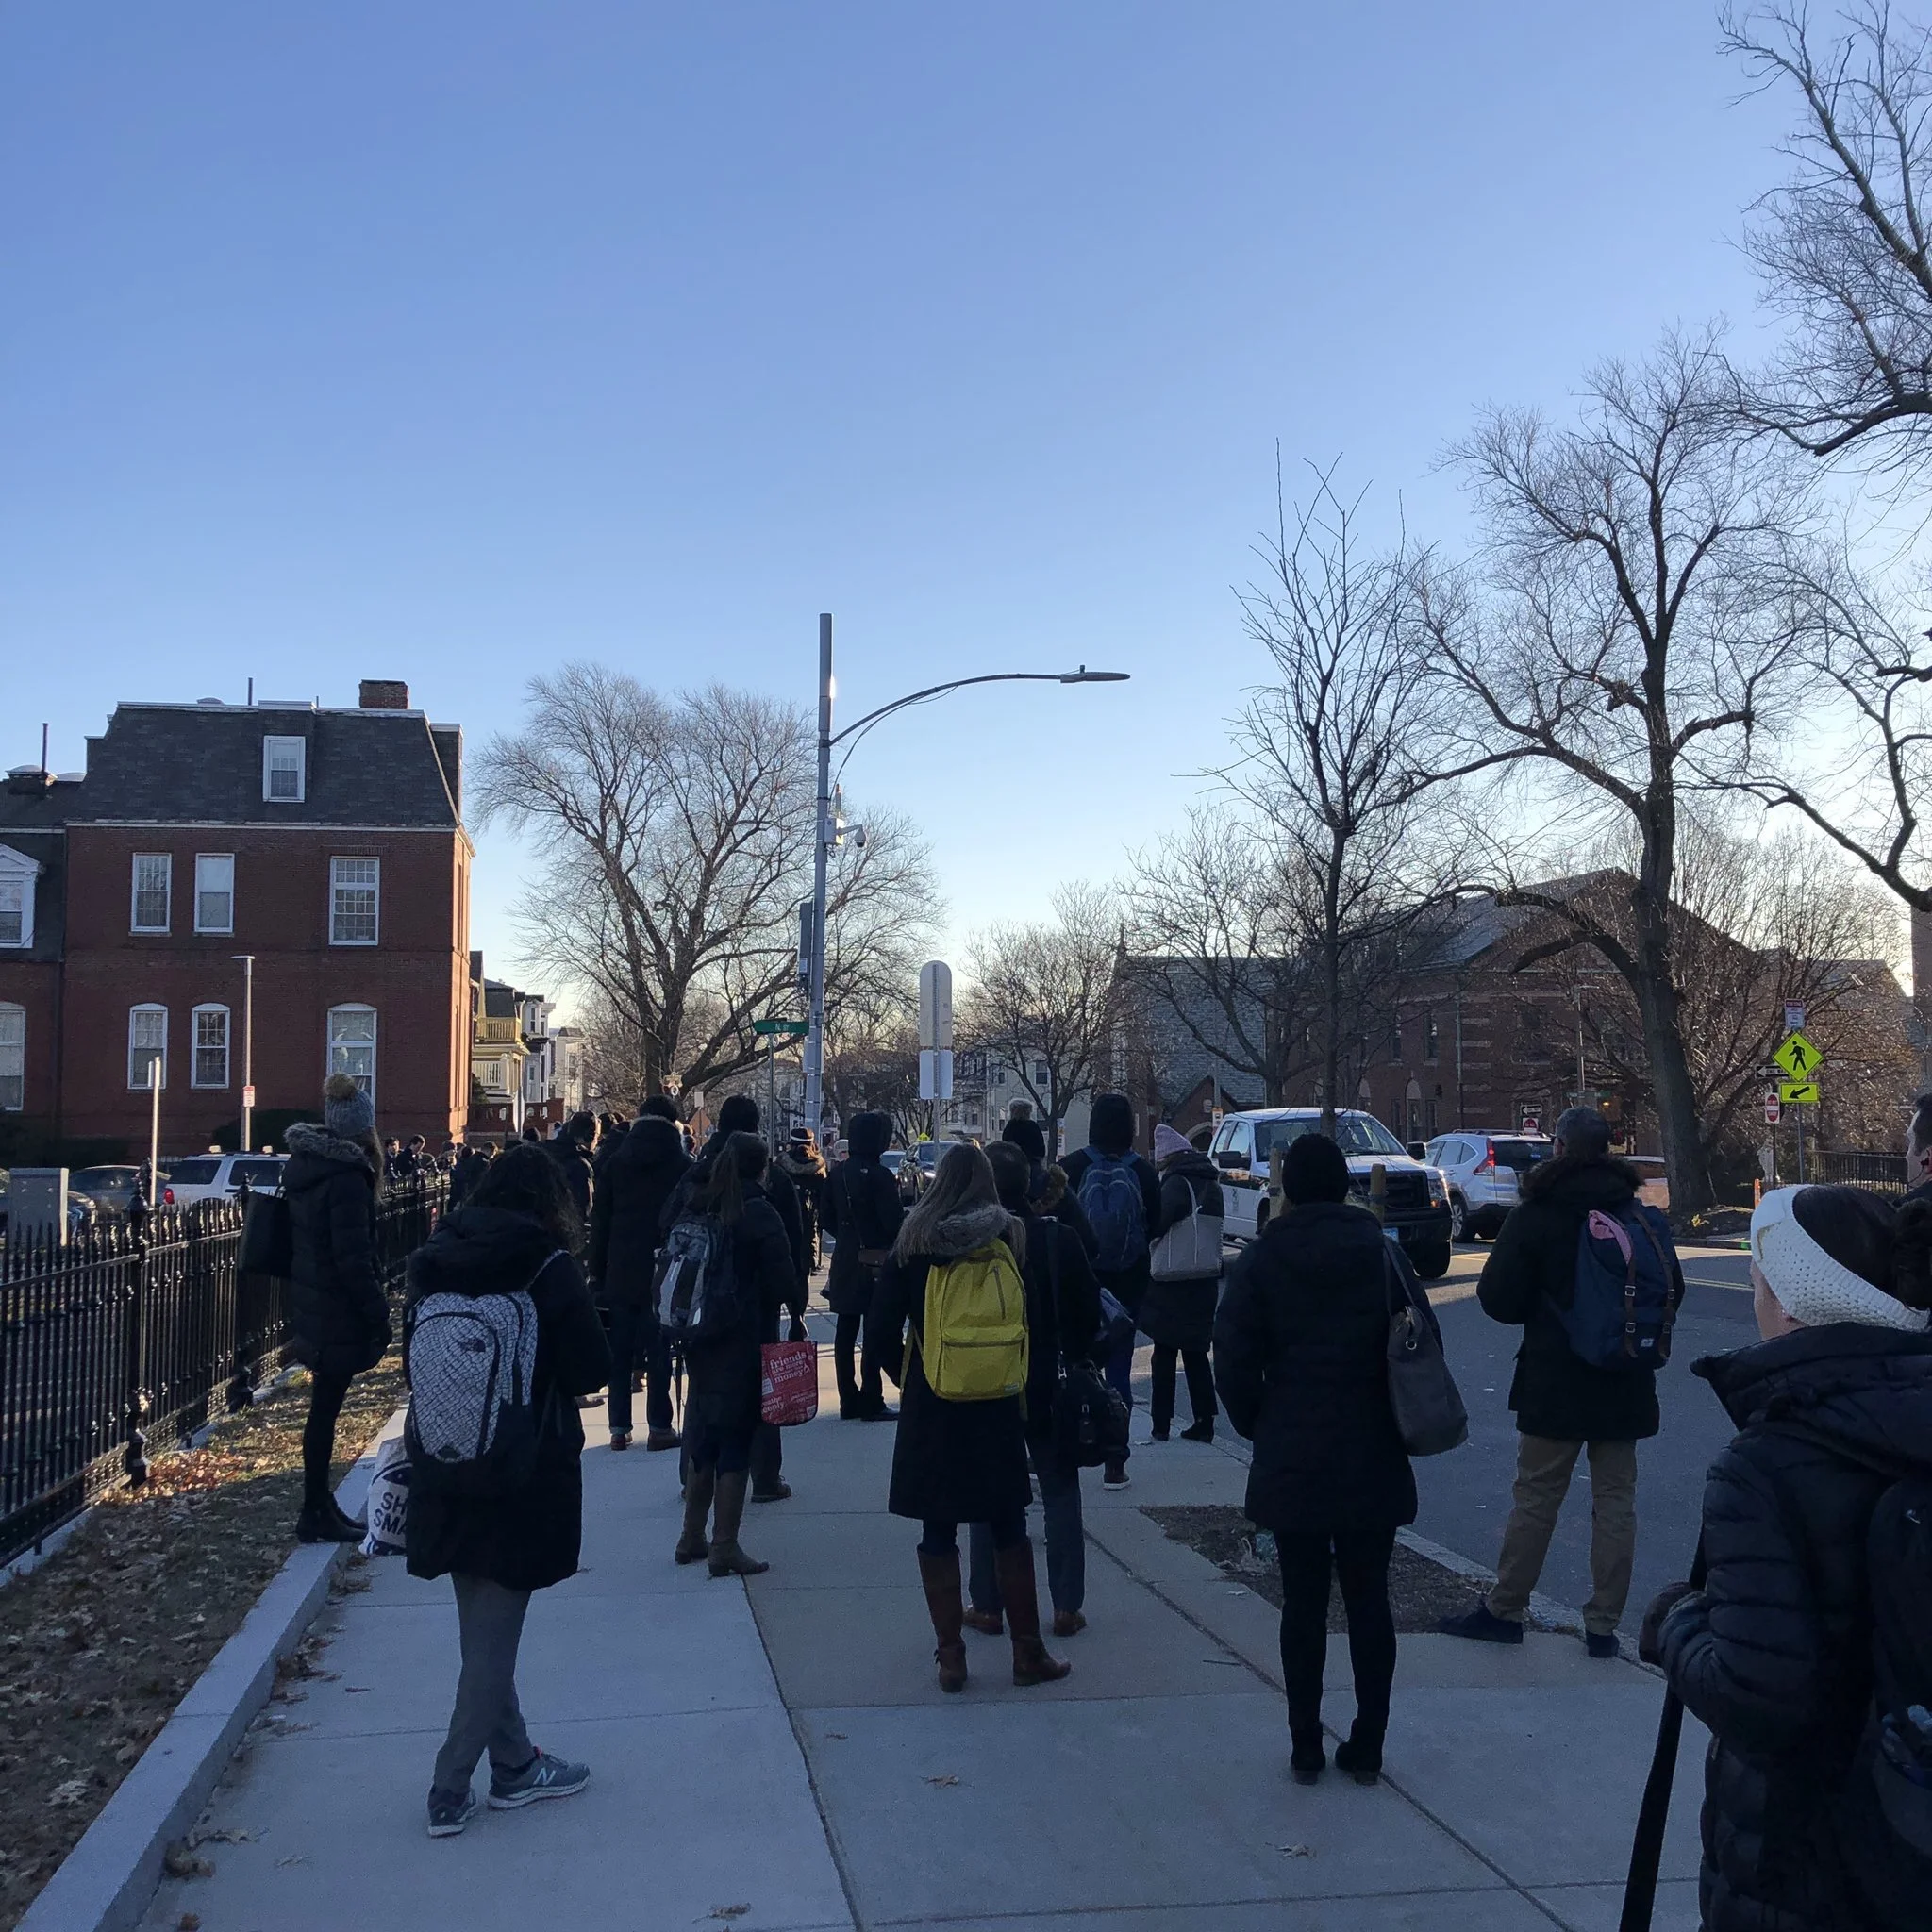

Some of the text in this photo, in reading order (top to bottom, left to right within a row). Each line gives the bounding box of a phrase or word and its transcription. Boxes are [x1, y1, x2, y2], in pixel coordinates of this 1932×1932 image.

[770, 1351, 807, 1369] friends
[785, 1360, 804, 1370] more
[774, 1368, 804, 1384] money
